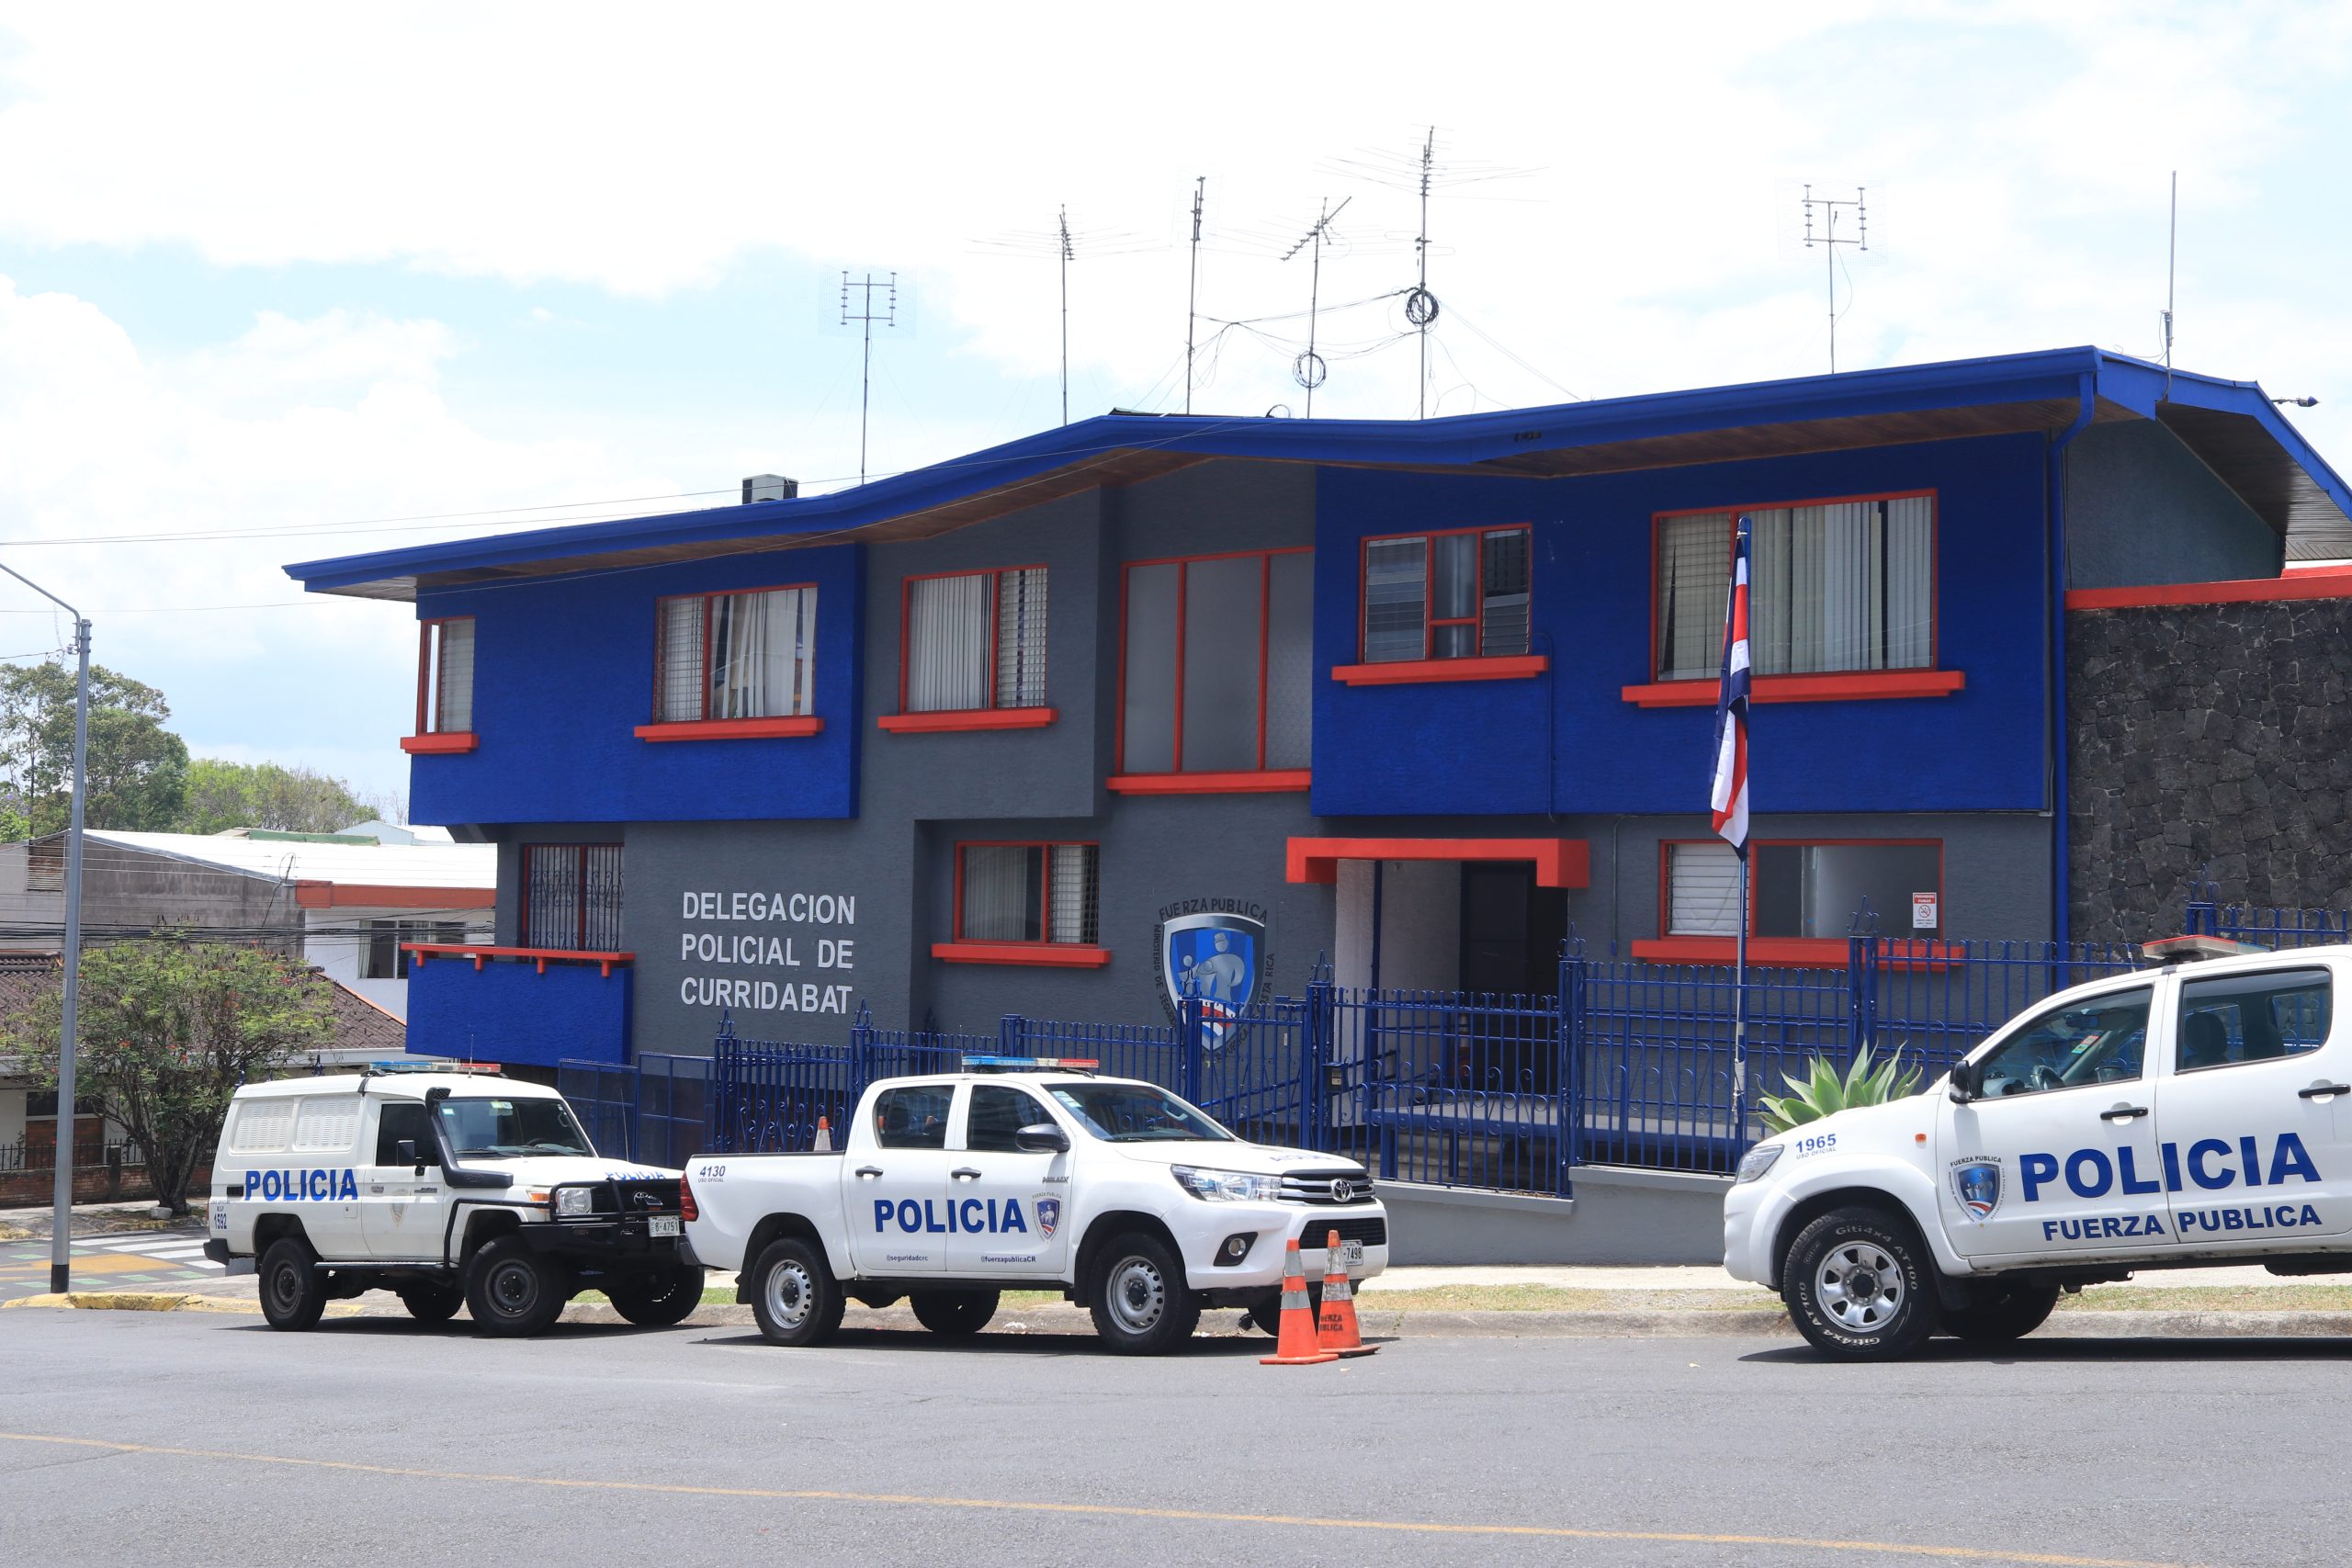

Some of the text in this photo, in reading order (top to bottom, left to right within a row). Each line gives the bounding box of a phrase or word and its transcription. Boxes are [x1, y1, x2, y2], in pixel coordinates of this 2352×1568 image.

[683, 891, 855, 924] DELEGACION
[1159, 897, 1268, 923] FUERZA PUBLICA
[682, 933, 854, 969] POLICIAL DE
[1265, 953, 1275, 977] RICA
[681, 976, 854, 1015] CURRIDABAT
[1795, 1134, 1837, 1154] 1965
[1796, 1146, 1837, 1160] USO OFICIAL
[699, 1165, 726, 1177] 4130
[1950, 1155, 2002, 1168] FUERZA PUBLICA
[2019, 1133, 2322, 1201] POLICIA
[244, 1168, 358, 1201] POLICIA
[213, 1213, 227, 1230] 1592
[874, 1199, 1027, 1234] POLICIA
[2042, 1204, 2323, 1242] FUERZA PUBLICA
[1894, 1245, 1918, 1291] AT100
[1798, 1281, 1823, 1325] AT100
